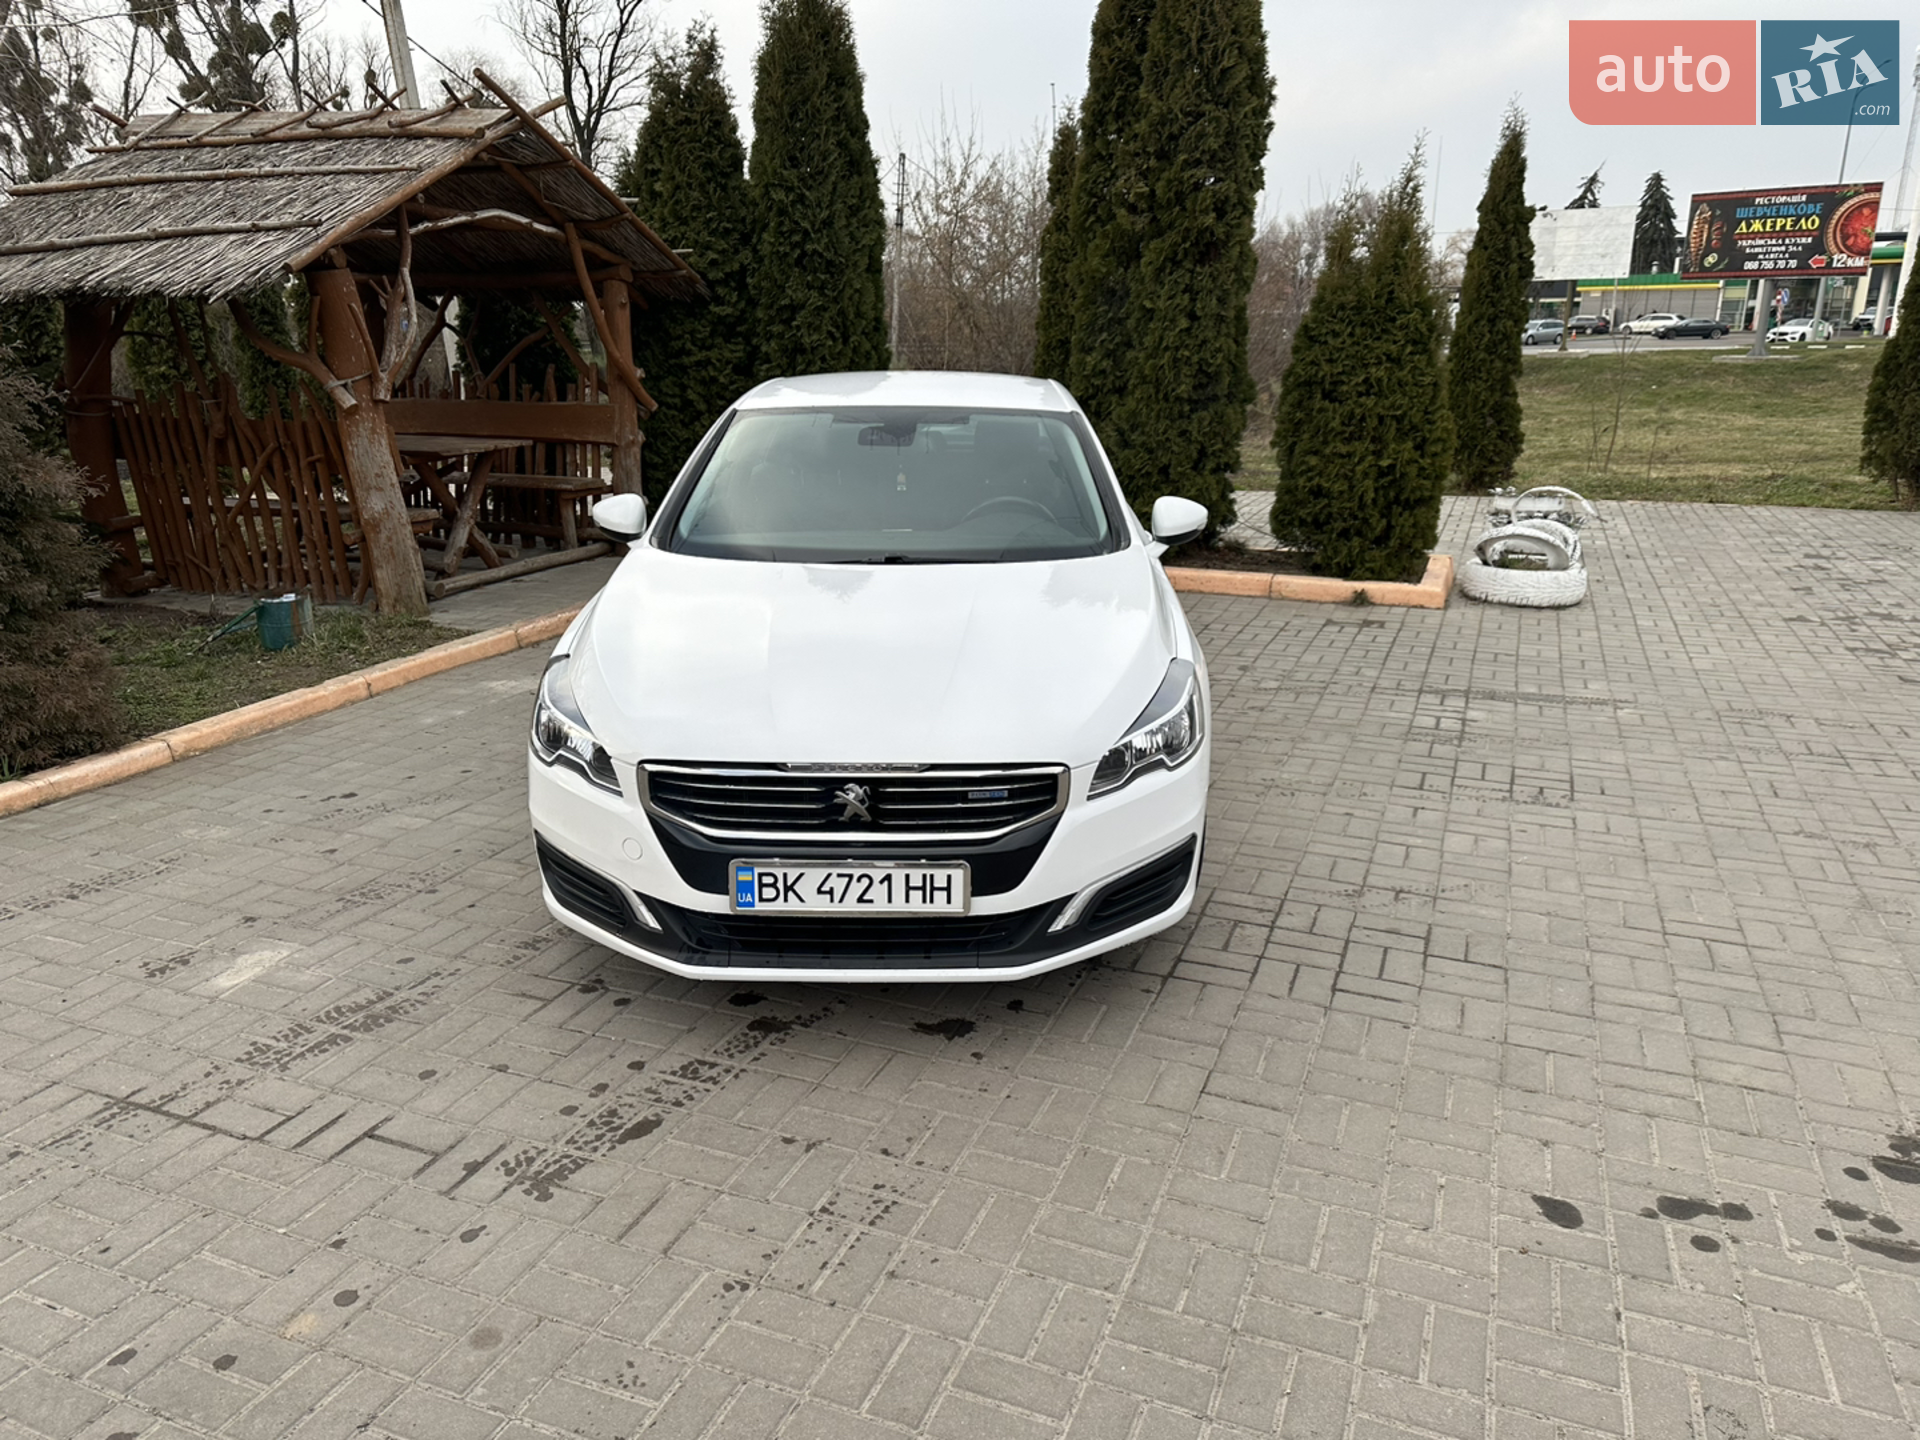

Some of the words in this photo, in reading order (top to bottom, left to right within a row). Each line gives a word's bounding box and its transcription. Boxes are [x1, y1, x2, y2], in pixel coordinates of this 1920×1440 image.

[1736, 203, 1824, 218] ШЕВЧЕНКОВЕ
[1734, 214, 1820, 234] ДЖЕРЕЛО
[1775, 260, 1786, 269] 70
[1787, 259, 1798, 269] 70
[738, 893, 753, 903] UA
[757, 873, 806, 904] BK
[816, 872, 894, 905] 4721
[904, 873, 951, 905] HH
